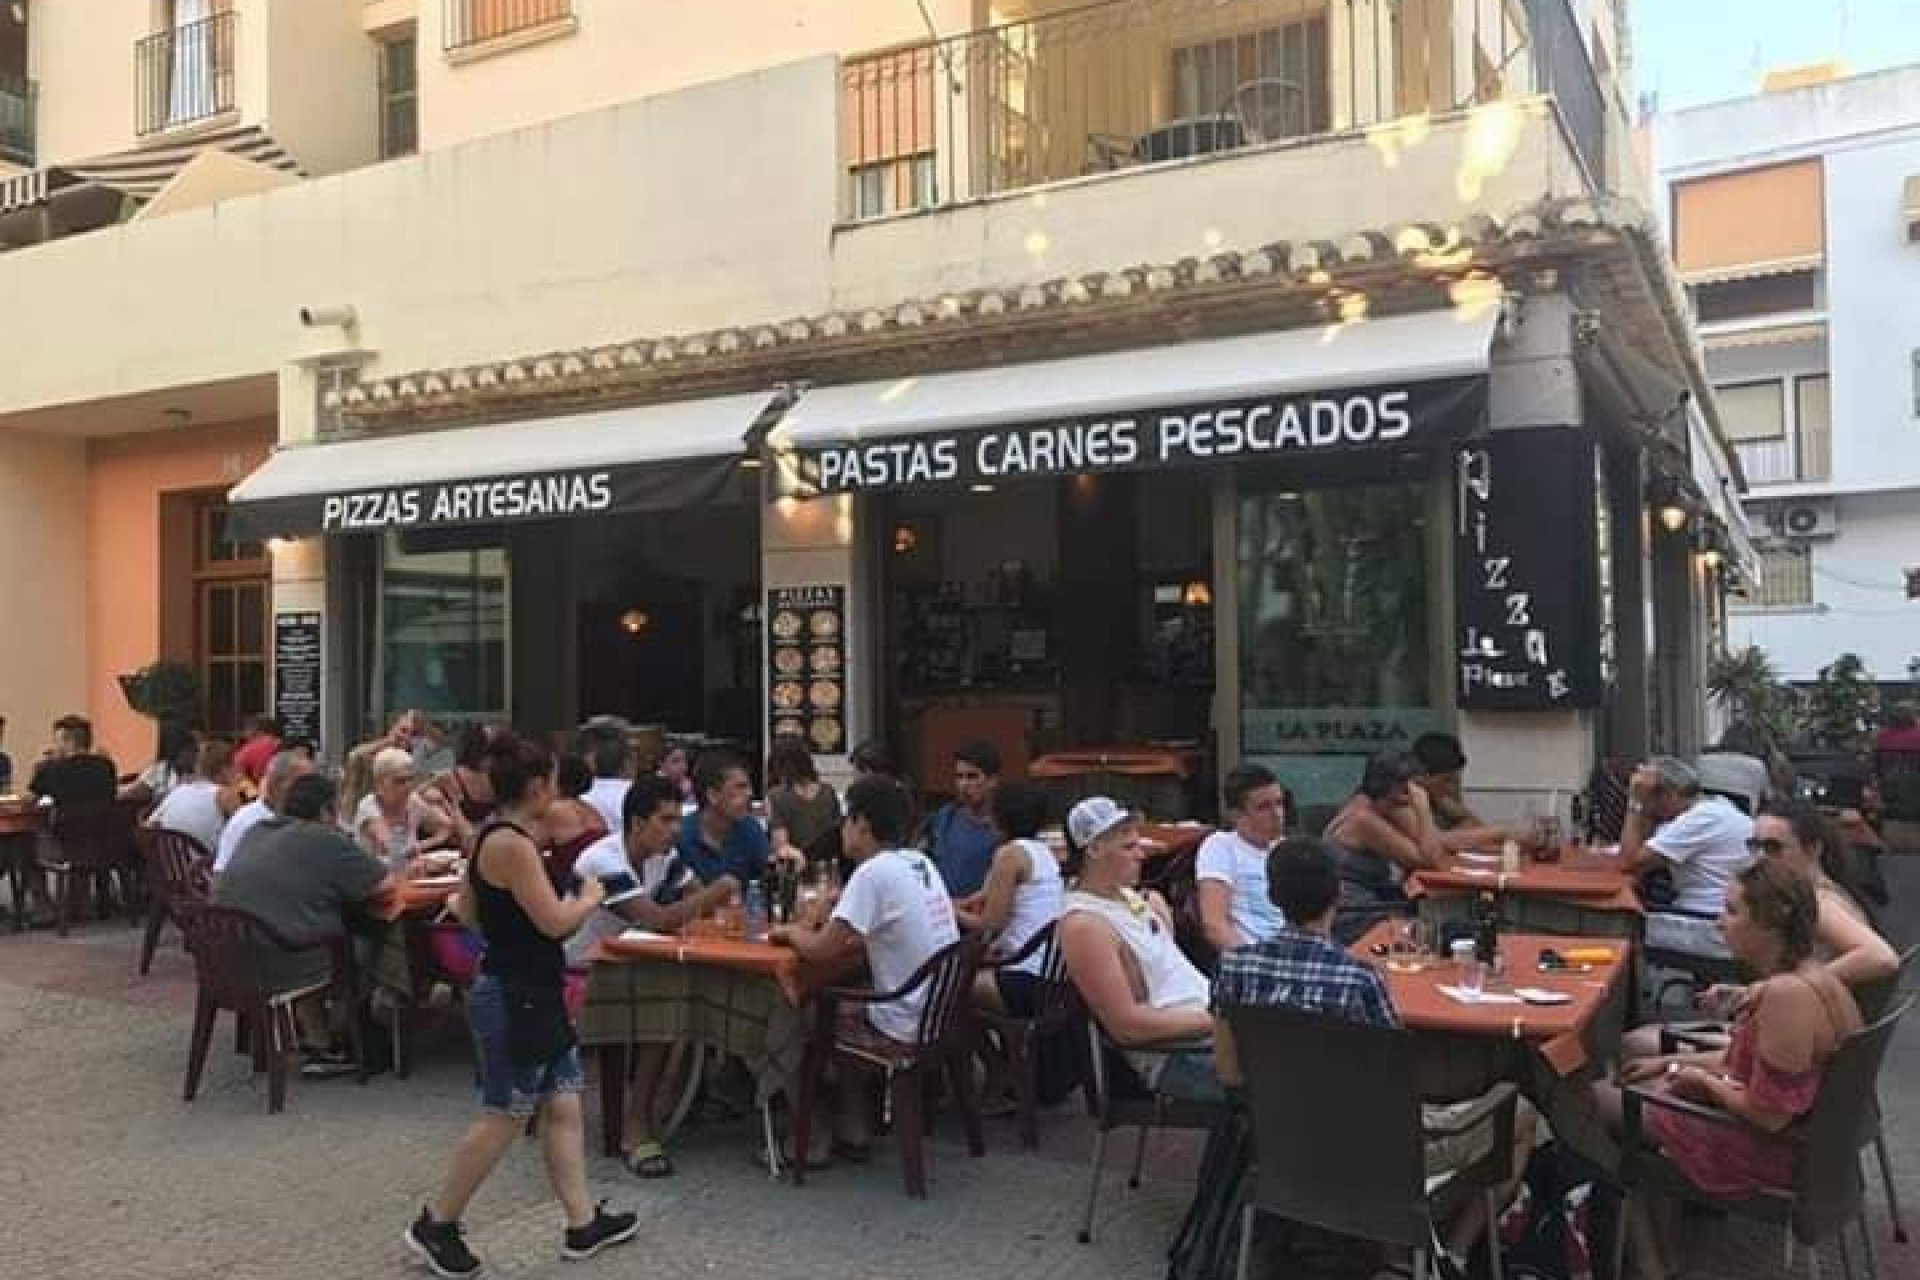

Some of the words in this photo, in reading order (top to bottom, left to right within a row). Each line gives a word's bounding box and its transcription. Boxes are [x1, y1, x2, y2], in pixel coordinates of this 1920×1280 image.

[819, 441, 957, 490] PASTAS
[977, 421, 1137, 477] CARNES
[1159, 391, 1411, 462] PESCADOS
[322, 490, 420, 530] PIZZAS
[431, 473, 611, 521] ARTESANAS
